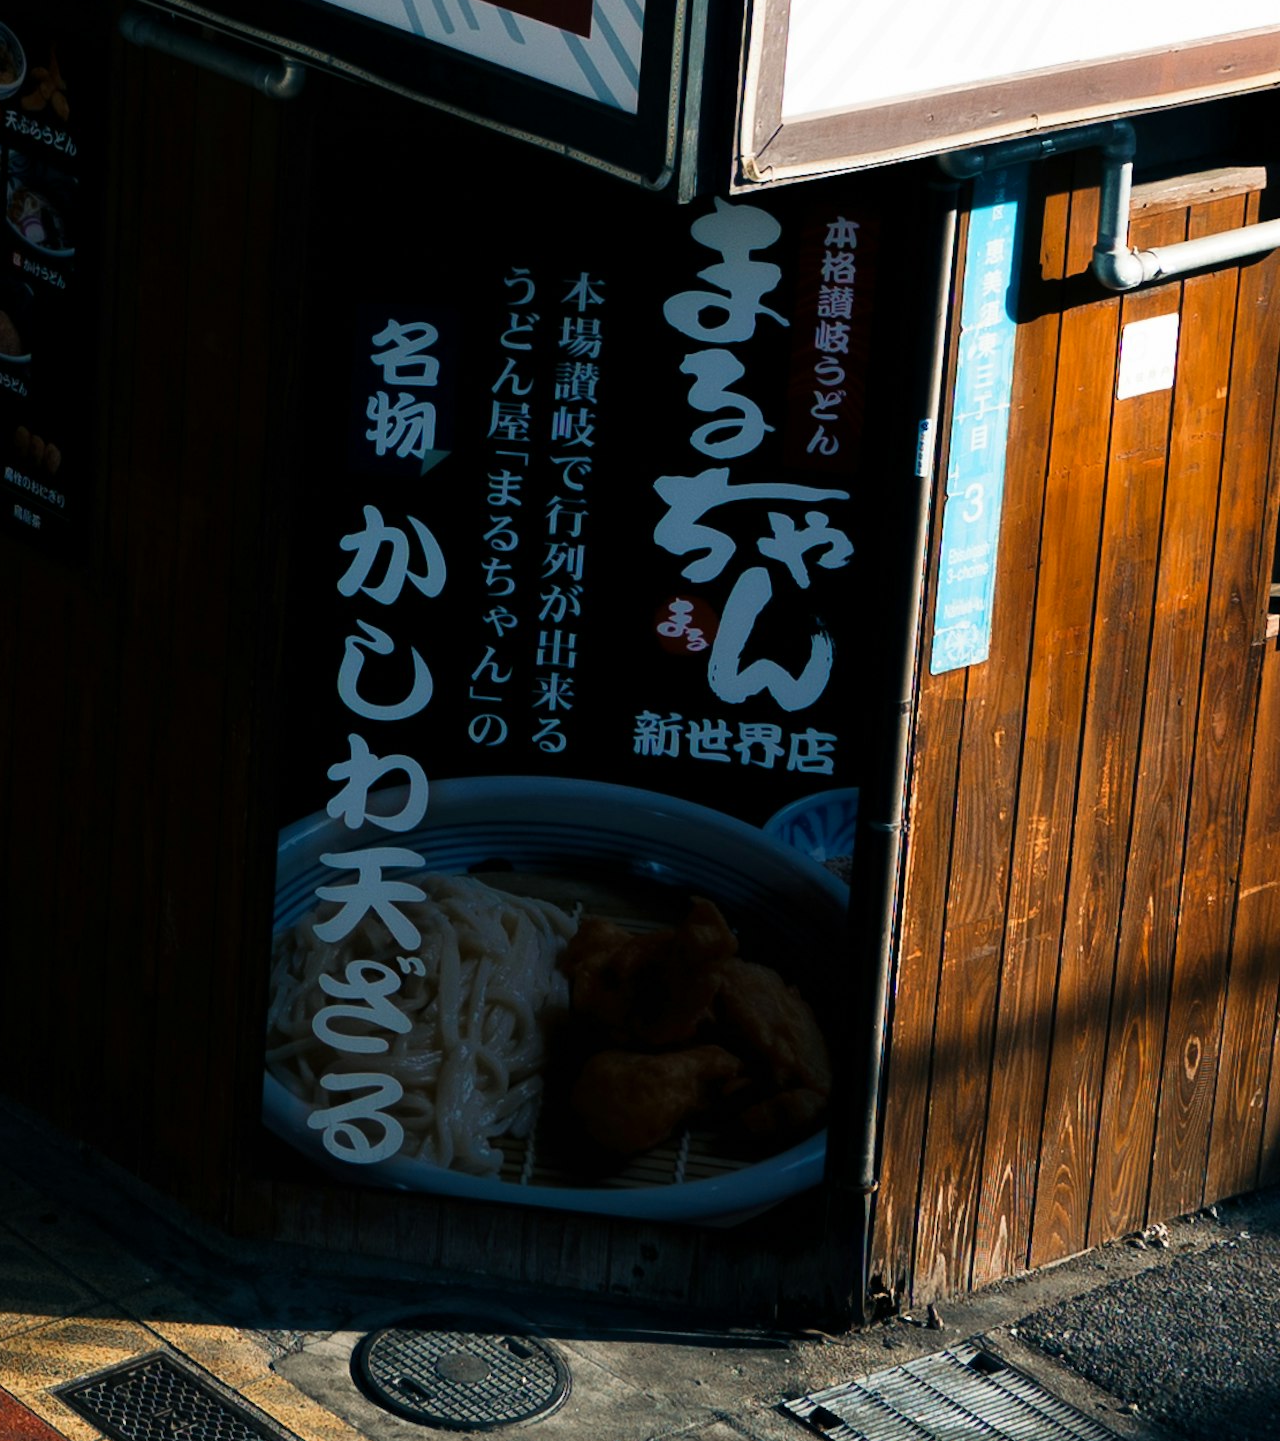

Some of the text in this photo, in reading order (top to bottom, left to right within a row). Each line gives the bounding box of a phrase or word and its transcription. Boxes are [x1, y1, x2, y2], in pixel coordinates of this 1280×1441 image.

[364, 318, 441, 462] 名物
[464, 263, 537, 751] うどん屋「まるちゃん」の
[528, 268, 609, 756] 本場讃岐で行列が出来る
[652, 193, 856, 713] まるちゃん
[804, 215, 863, 459] 本格讃岐うどん
[961, 481, 986, 524] 3
[306, 504, 449, 1167] かしわ天ざる
[632, 707, 839, 777] 新世界店
